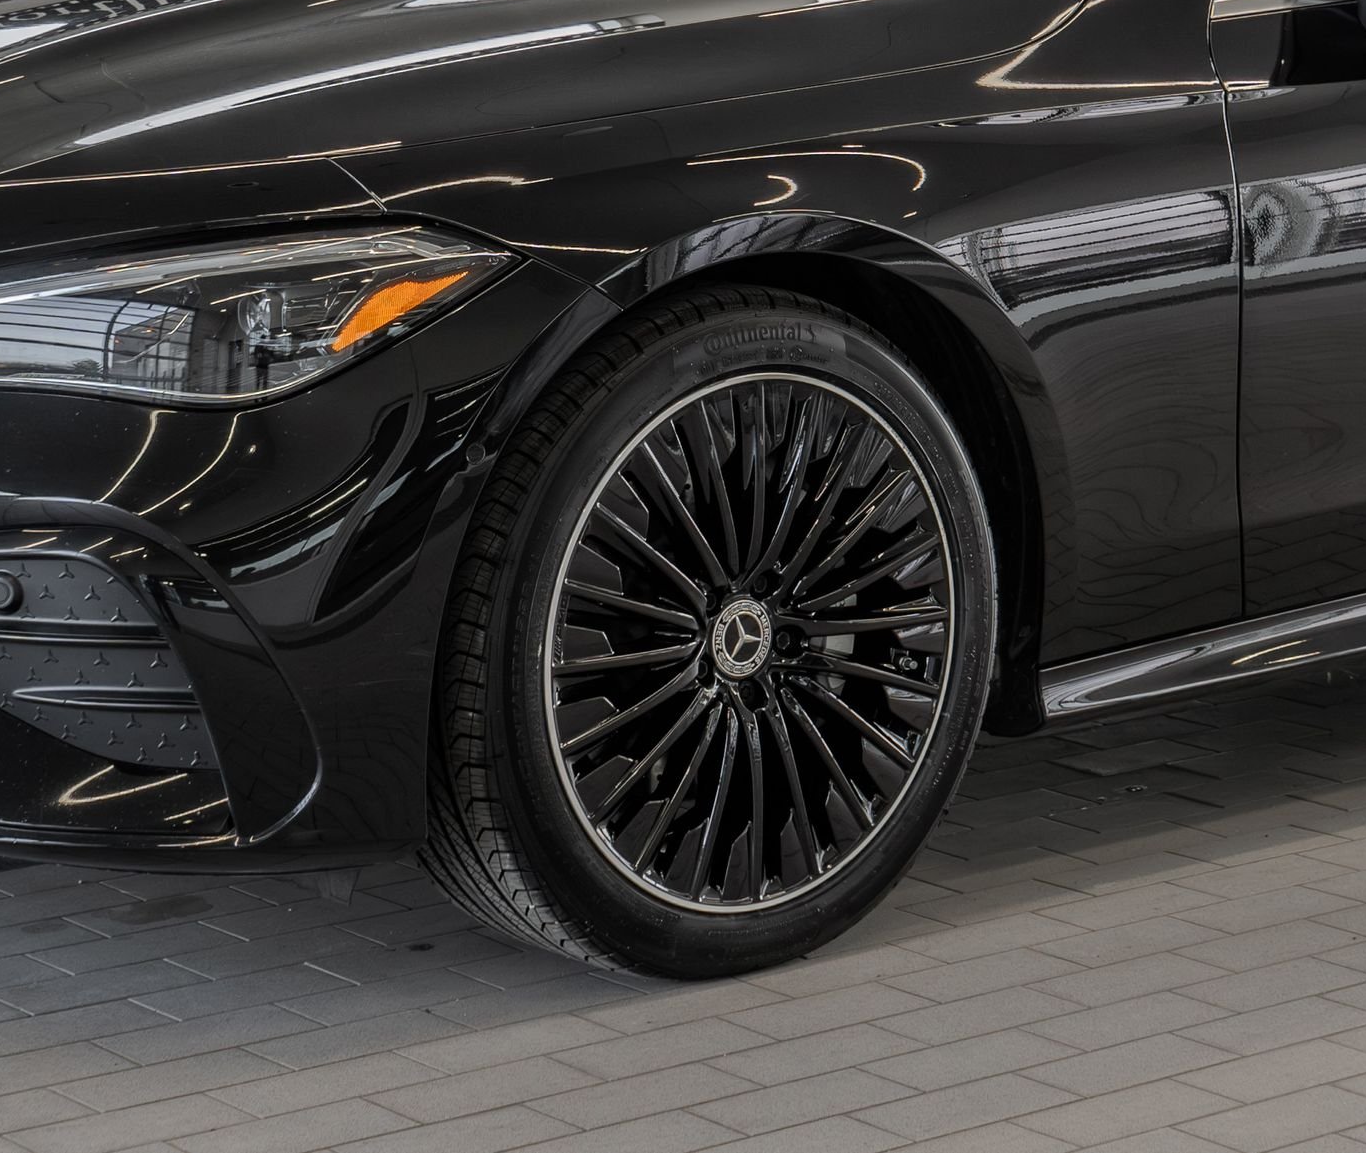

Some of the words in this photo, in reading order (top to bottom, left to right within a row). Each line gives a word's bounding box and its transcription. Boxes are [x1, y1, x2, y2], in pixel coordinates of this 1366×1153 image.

[703, 321, 802, 356] Continental
[715, 623, 725, 651] BENZ
[755, 614, 770, 665] MERCEDES
